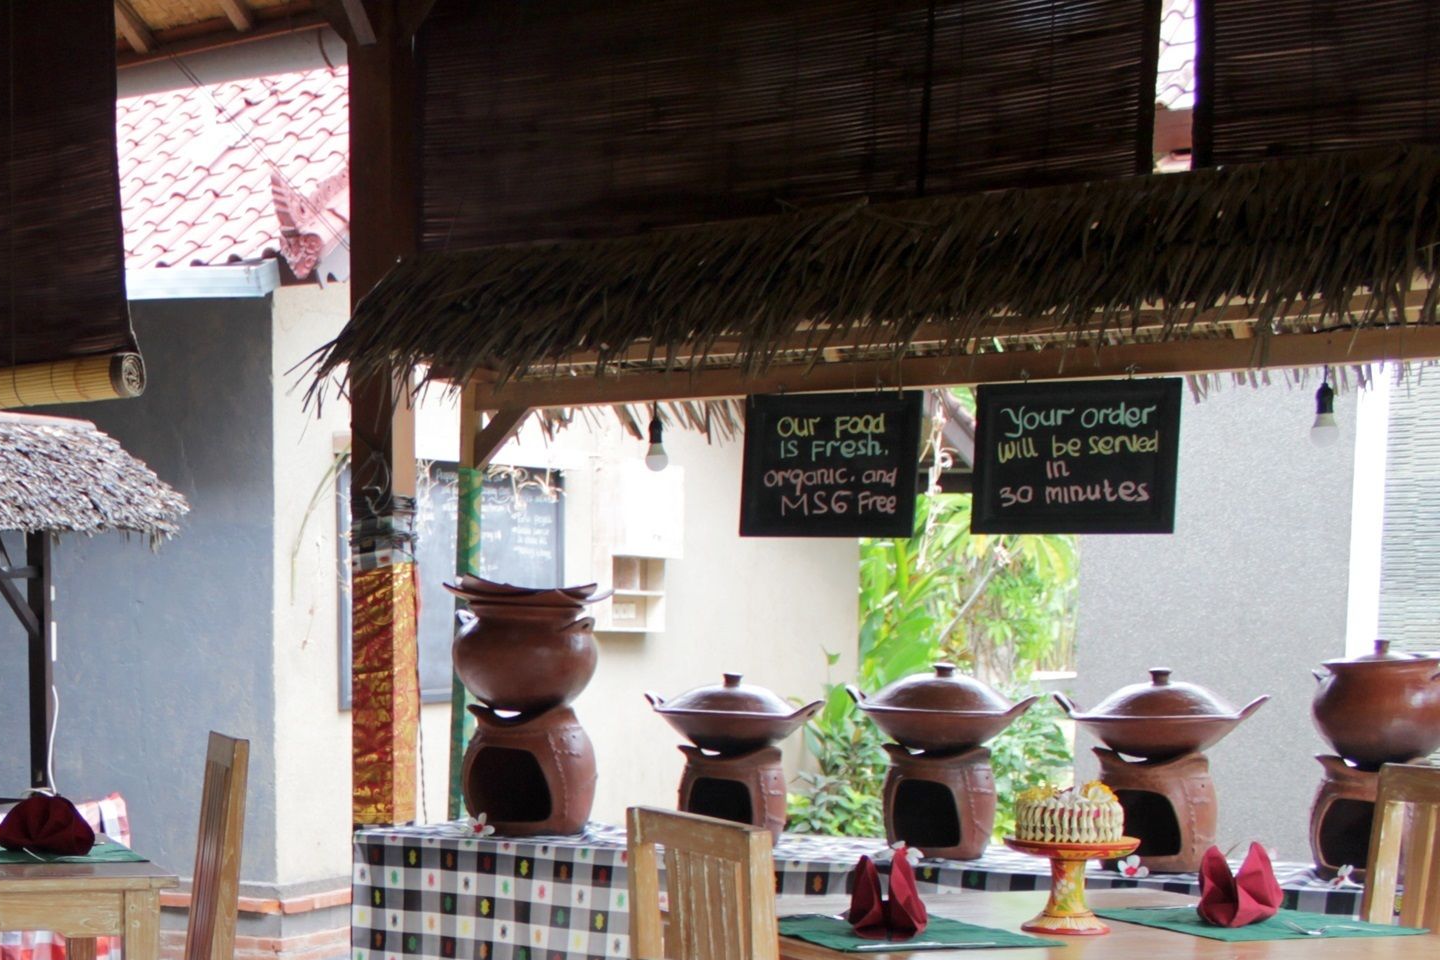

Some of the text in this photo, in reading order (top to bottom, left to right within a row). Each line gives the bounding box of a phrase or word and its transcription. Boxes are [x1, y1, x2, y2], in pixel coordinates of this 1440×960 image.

[777, 412, 886, 439] Our Food
[1081, 401, 1157, 428] order
[1051, 434, 1081, 458] be
[1089, 429, 1159, 455] served
[861, 467, 898, 487] and
[858, 491, 897, 515] Free
[999, 485, 1034, 508] 30
